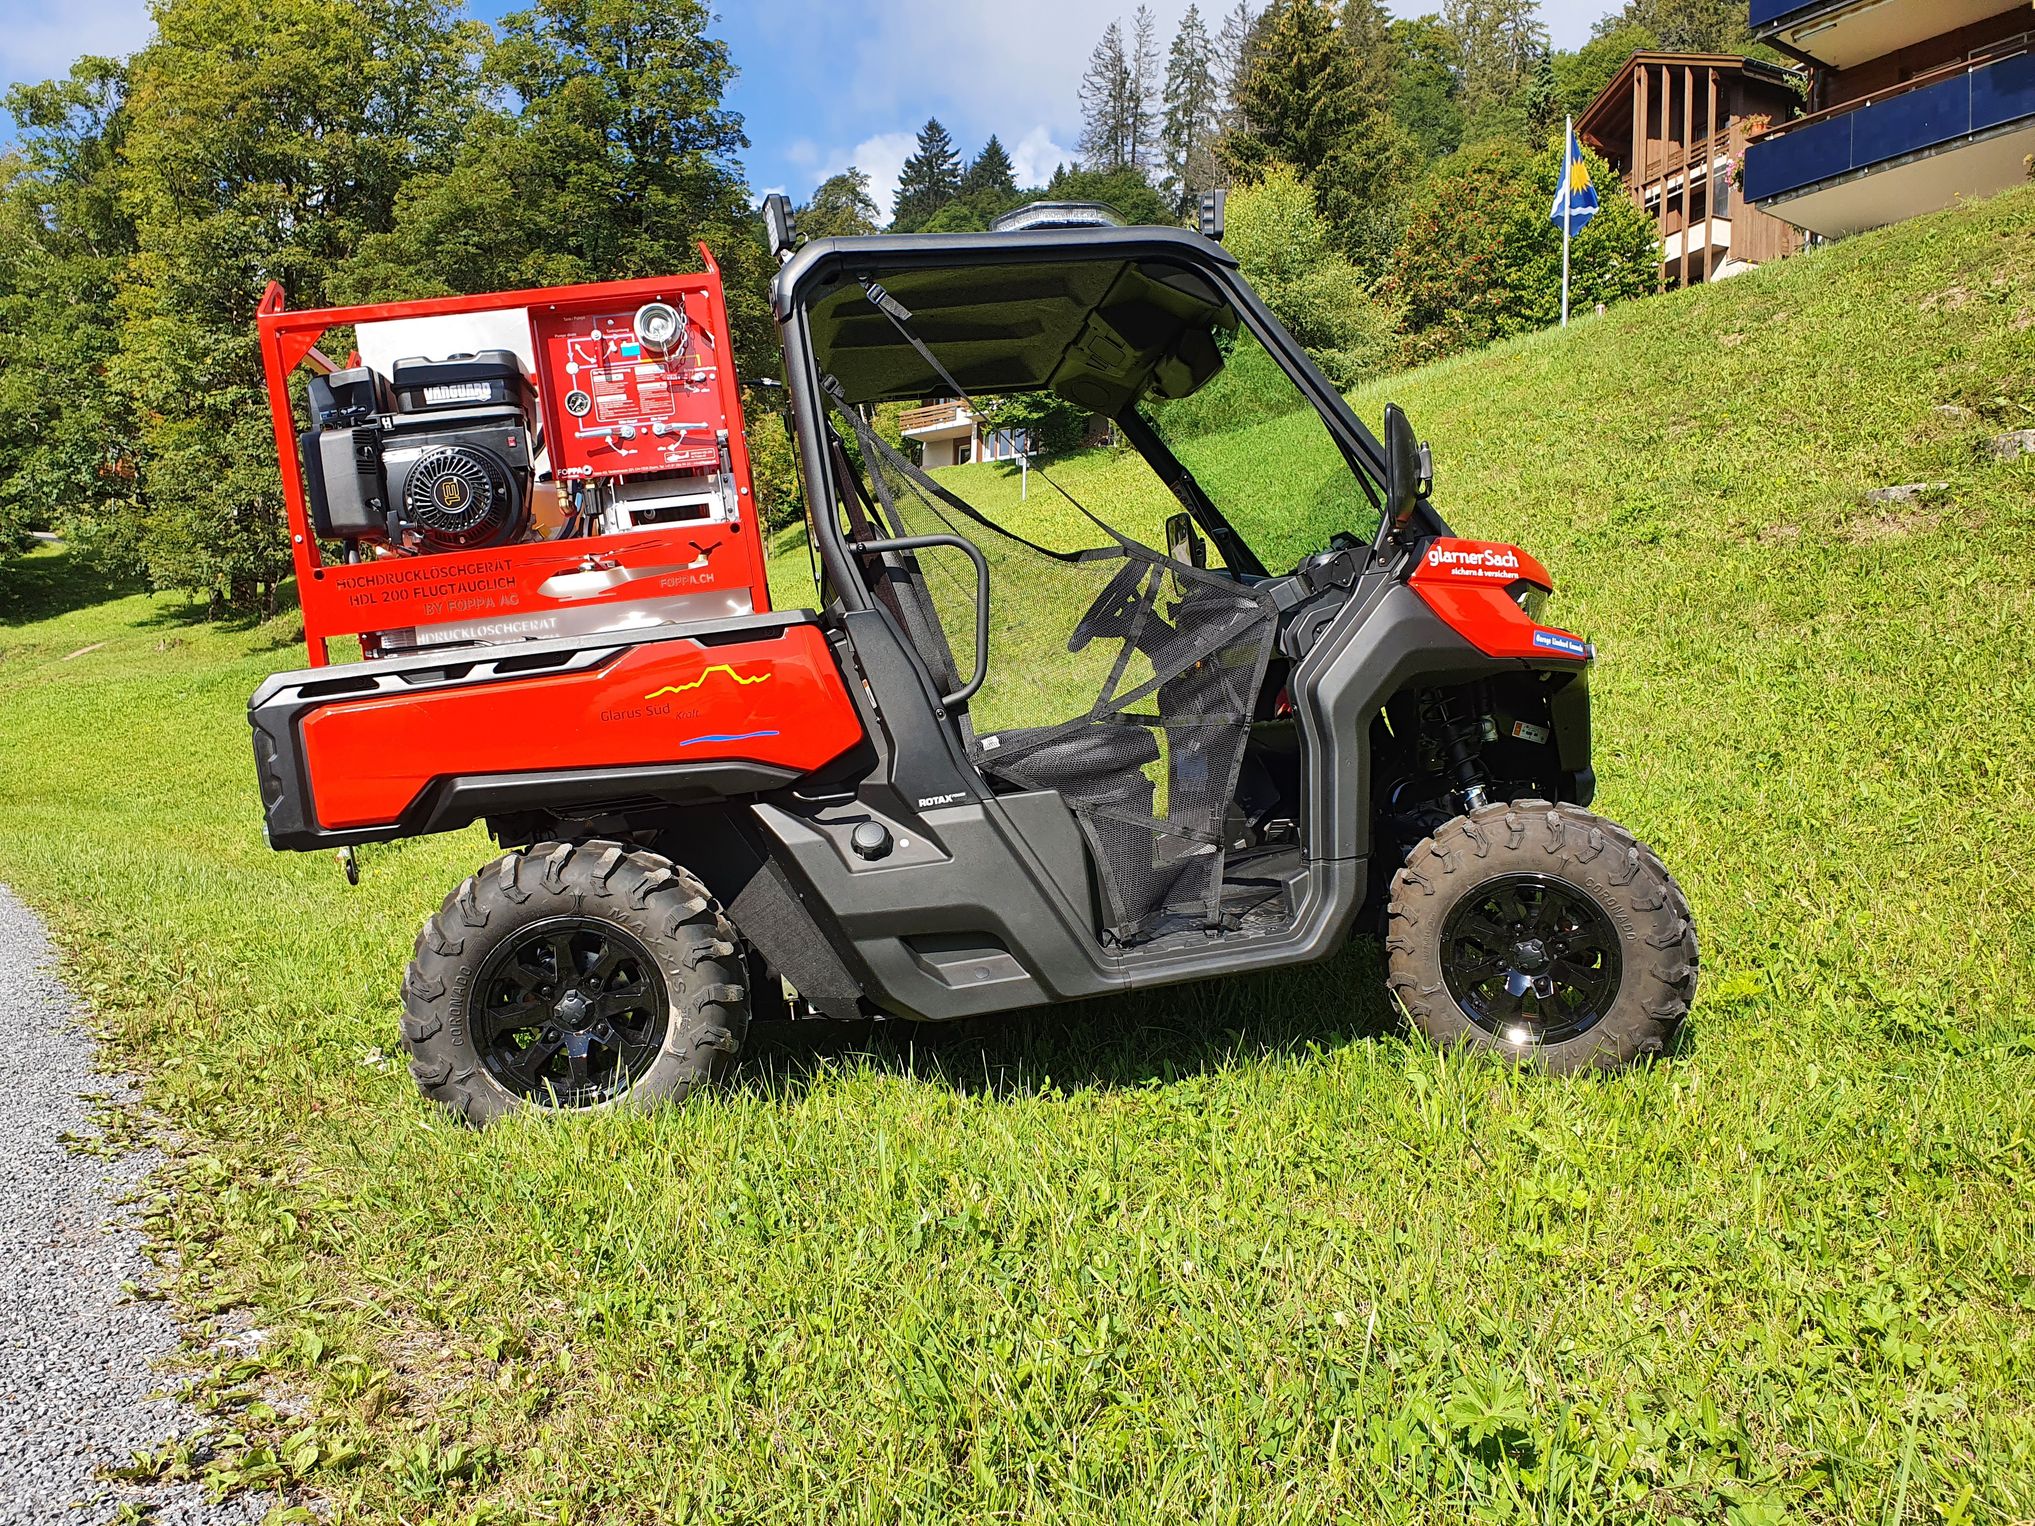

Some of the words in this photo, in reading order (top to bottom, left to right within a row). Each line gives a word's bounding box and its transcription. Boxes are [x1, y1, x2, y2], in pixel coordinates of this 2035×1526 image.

[423, 382, 492, 402] VANGUARD
[557, 466, 583, 476] FOPPA
[1428, 546, 1519, 568] glarnerSach
[336, 559, 513, 590] HOCHDRUCKLÖSCHGERÄT
[660, 573, 715, 588] FOPPA.CH
[1451, 567, 1477, 576] sichern
[1477, 568, 1484, 577] &
[1484, 569, 1519, 579] versichern
[350, 592, 377, 607] HDL
[382, 588, 409, 604] 200
[413, 576, 516, 599] FLUGTAUGLICH
[424, 602, 443, 616] BY
[448, 596, 495, 612] FOPPA
[500, 594, 520, 607] AG
[600, 709, 642, 722] Glarus
[645, 703, 671, 717] Süd
[918, 794, 953, 808] ROTAX
[1584, 876, 1637, 941] CORONADO
[607, 906, 687, 994] MAXXIS
[448, 965, 473, 1047] CORONADO
